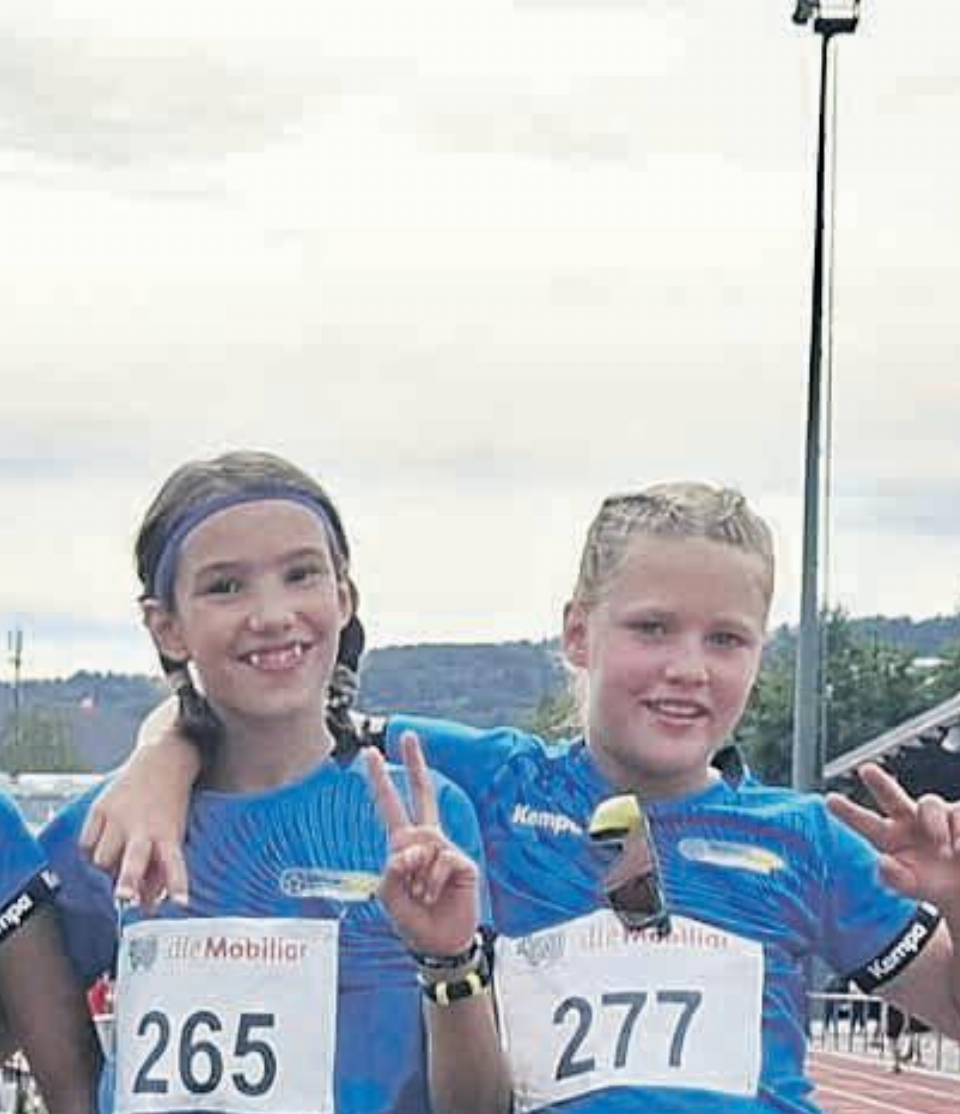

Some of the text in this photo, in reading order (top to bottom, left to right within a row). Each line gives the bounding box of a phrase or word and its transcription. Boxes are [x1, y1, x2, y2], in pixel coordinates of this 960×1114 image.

[203, 936, 307, 962] Mobiliar
[866, 922, 928, 979] Kempa
[132, 1010, 278, 1096] 265
[552, 990, 702, 1082] 277
